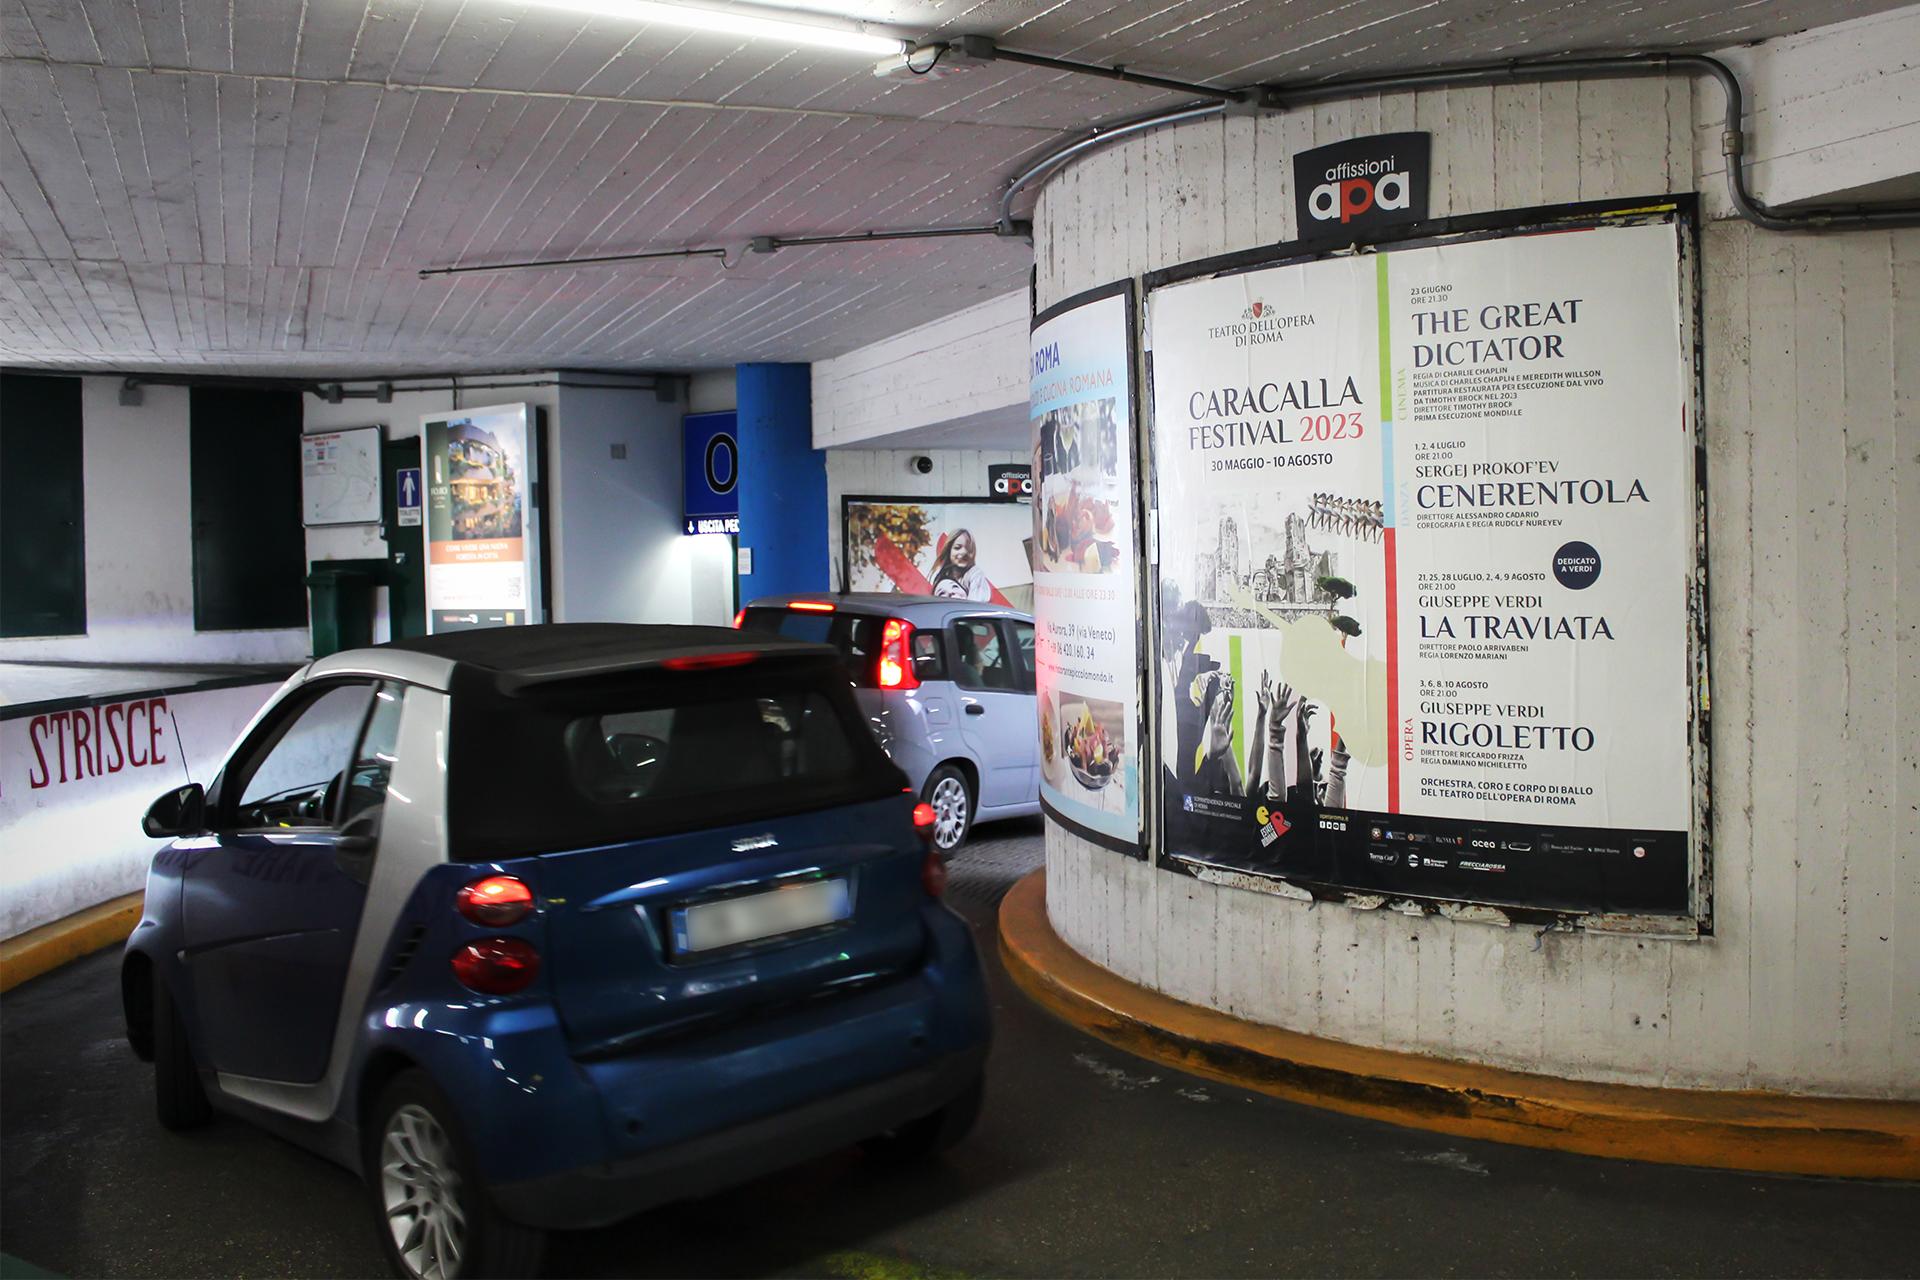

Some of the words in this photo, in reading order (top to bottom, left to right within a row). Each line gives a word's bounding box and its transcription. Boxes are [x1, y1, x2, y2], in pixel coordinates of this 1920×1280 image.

[1326, 155, 1394, 181] affissioni
[1309, 171, 1409, 224] apa
[1421, 285, 1452, 294] GIUGNO
[1412, 309, 1470, 335] THE
[1480, 299, 1583, 330] GREAT
[1209, 323, 1246, 339] TEATRO
[1249, 314, 1315, 333] DELL'OPERA
[1235, 336, 1247, 347] DI
[1250, 331, 1283, 345] ROMA
[1035, 341, 1060, 376] ROMA
[1413, 335, 1564, 368] DICTATOR
[1070, 367, 1114, 395] ROMANA
[1413, 380, 1440, 388] MUSICA
[1449, 378, 1482, 386] CHARLES
[1483, 375, 1515, 384] CHAPLIN
[1522, 372, 1563, 381] MEREDITH
[1565, 370, 1601, 378] WILLSON
[1443, 369, 1473, 377] CHARLIE
[1475, 367, 1507, 375] CHAPLIN
[1414, 388, 1452, 396] PARTITURA
[1454, 385, 1500, 393] RESTAURATA
[1517, 381, 1565, 390] ESECUZIONE
[1584, 378, 1603, 386] VIVO
[1189, 376, 1363, 420] CARACALLA
[1425, 396, 1457, 404] TIMOTHY
[1414, 405, 1452, 413] DIRETTORE
[1454, 403, 1486, 411] TIMOTHY
[1438, 411, 1482, 420] ESECUZIONE
[1484, 410, 1522, 418] MONDIALE
[1189, 419, 1293, 450] FESTIVAL
[1300, 412, 1364, 442] 2023
[1437, 441, 1465, 449] LUGLIO
[1212, 460, 1223, 471] 30
[1225, 457, 1264, 470] MAGGIO
[1274, 456, 1285, 467] 10
[1288, 453, 1332, 466] AGOSTO
[1416, 463, 1468, 478] SERGEJ
[1473, 461, 1559, 475] PROKOF'EV
[1417, 479, 1651, 508] CENERENTOLA
[1417, 521, 1465, 529] COREOGRAFIA
[1419, 596, 1489, 607] GIUSEPPE
[1495, 596, 1542, 608] VERDI
[1068, 624, 1075, 637] 39
[1088, 626, 1116, 644] Veneto)
[1419, 616, 1456, 638] LA
[1464, 616, 1614, 640] TRAVIATA
[1456, 681, 1488, 689] AGOSTO
[1420, 702, 1492, 716] GIUSEPPE
[1496, 704, 1544, 717] VERDI
[29, 698, 168, 789] STRISCE
[1405, 718, 1414, 761] OPERA
[1421, 721, 1594, 752] RIGOLETTO
[1442, 759, 1477, 767] DAMIANO
[1478, 761, 1527, 769] MICHIELETTO
[1460, 751, 1496, 759] RICCARDO
[1421, 789, 1437, 797] DEL
[1440, 790, 1473, 799] TEATRO
[1476, 792, 1531, 803] DELL'OPERA
[1534, 795, 1544, 803] DI
[1547, 796, 1576, 805] ROMA
[1478, 782, 1503, 790] CORO
[1513, 784, 1546, 793] CORPO
[1549, 785, 1559, 793] DI
[1562, 786, 1593, 795] BALLO
[1471, 839, 1496, 849] acea
